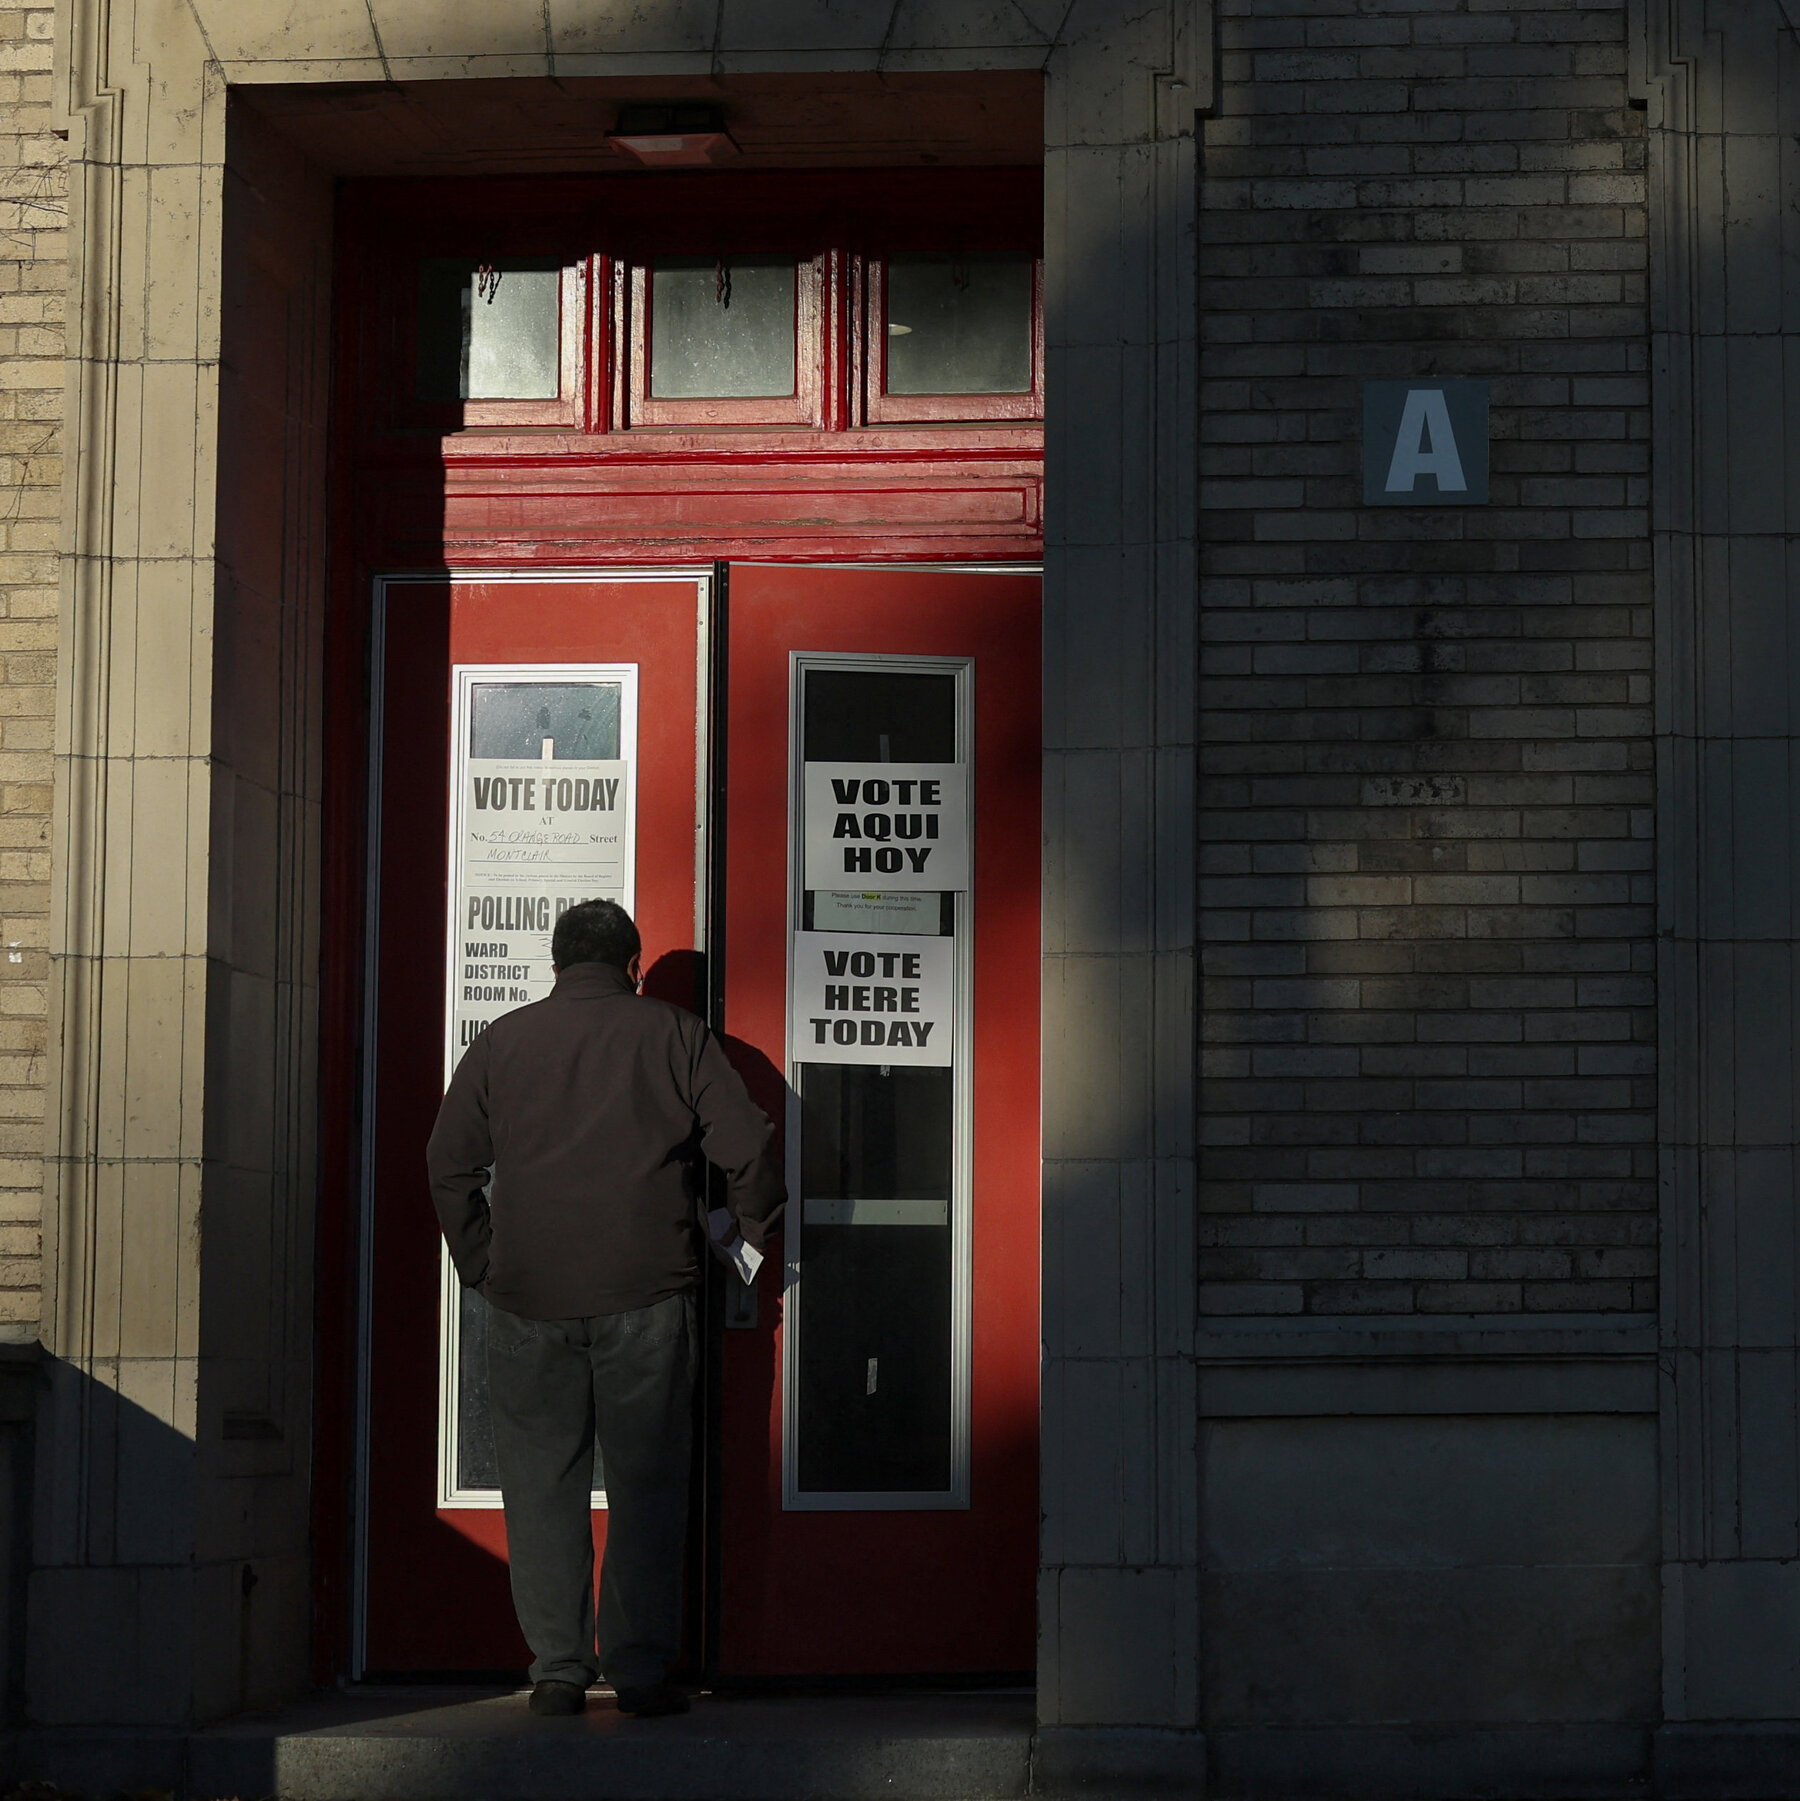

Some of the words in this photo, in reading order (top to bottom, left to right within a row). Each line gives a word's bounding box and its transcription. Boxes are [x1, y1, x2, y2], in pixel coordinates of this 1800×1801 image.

[1384, 389, 1468, 492] A
[473, 777, 535, 811] VOTE
[542, 778, 619, 812] TODAY
[831, 778, 941, 806] VOTE
[539, 816, 555, 825] AT
[832, 813, 939, 842] AQUI
[470, 832, 488, 842] No.
[552, 832, 581, 844] ROAD
[590, 834, 617, 844] Street
[487, 848, 552, 861] MONTCLAIR
[843, 847, 932, 873] HOY
[468, 895, 550, 932] POLLING
[465, 942, 508, 958] WARD
[464, 963, 530, 980] DISTRICT
[823, 950, 921, 979] VOTE
[463, 985, 505, 1002] ROOM
[509, 986, 531, 1002] No.
[824, 984, 920, 1013] HERE
[809, 1018, 935, 1048] TODAY
